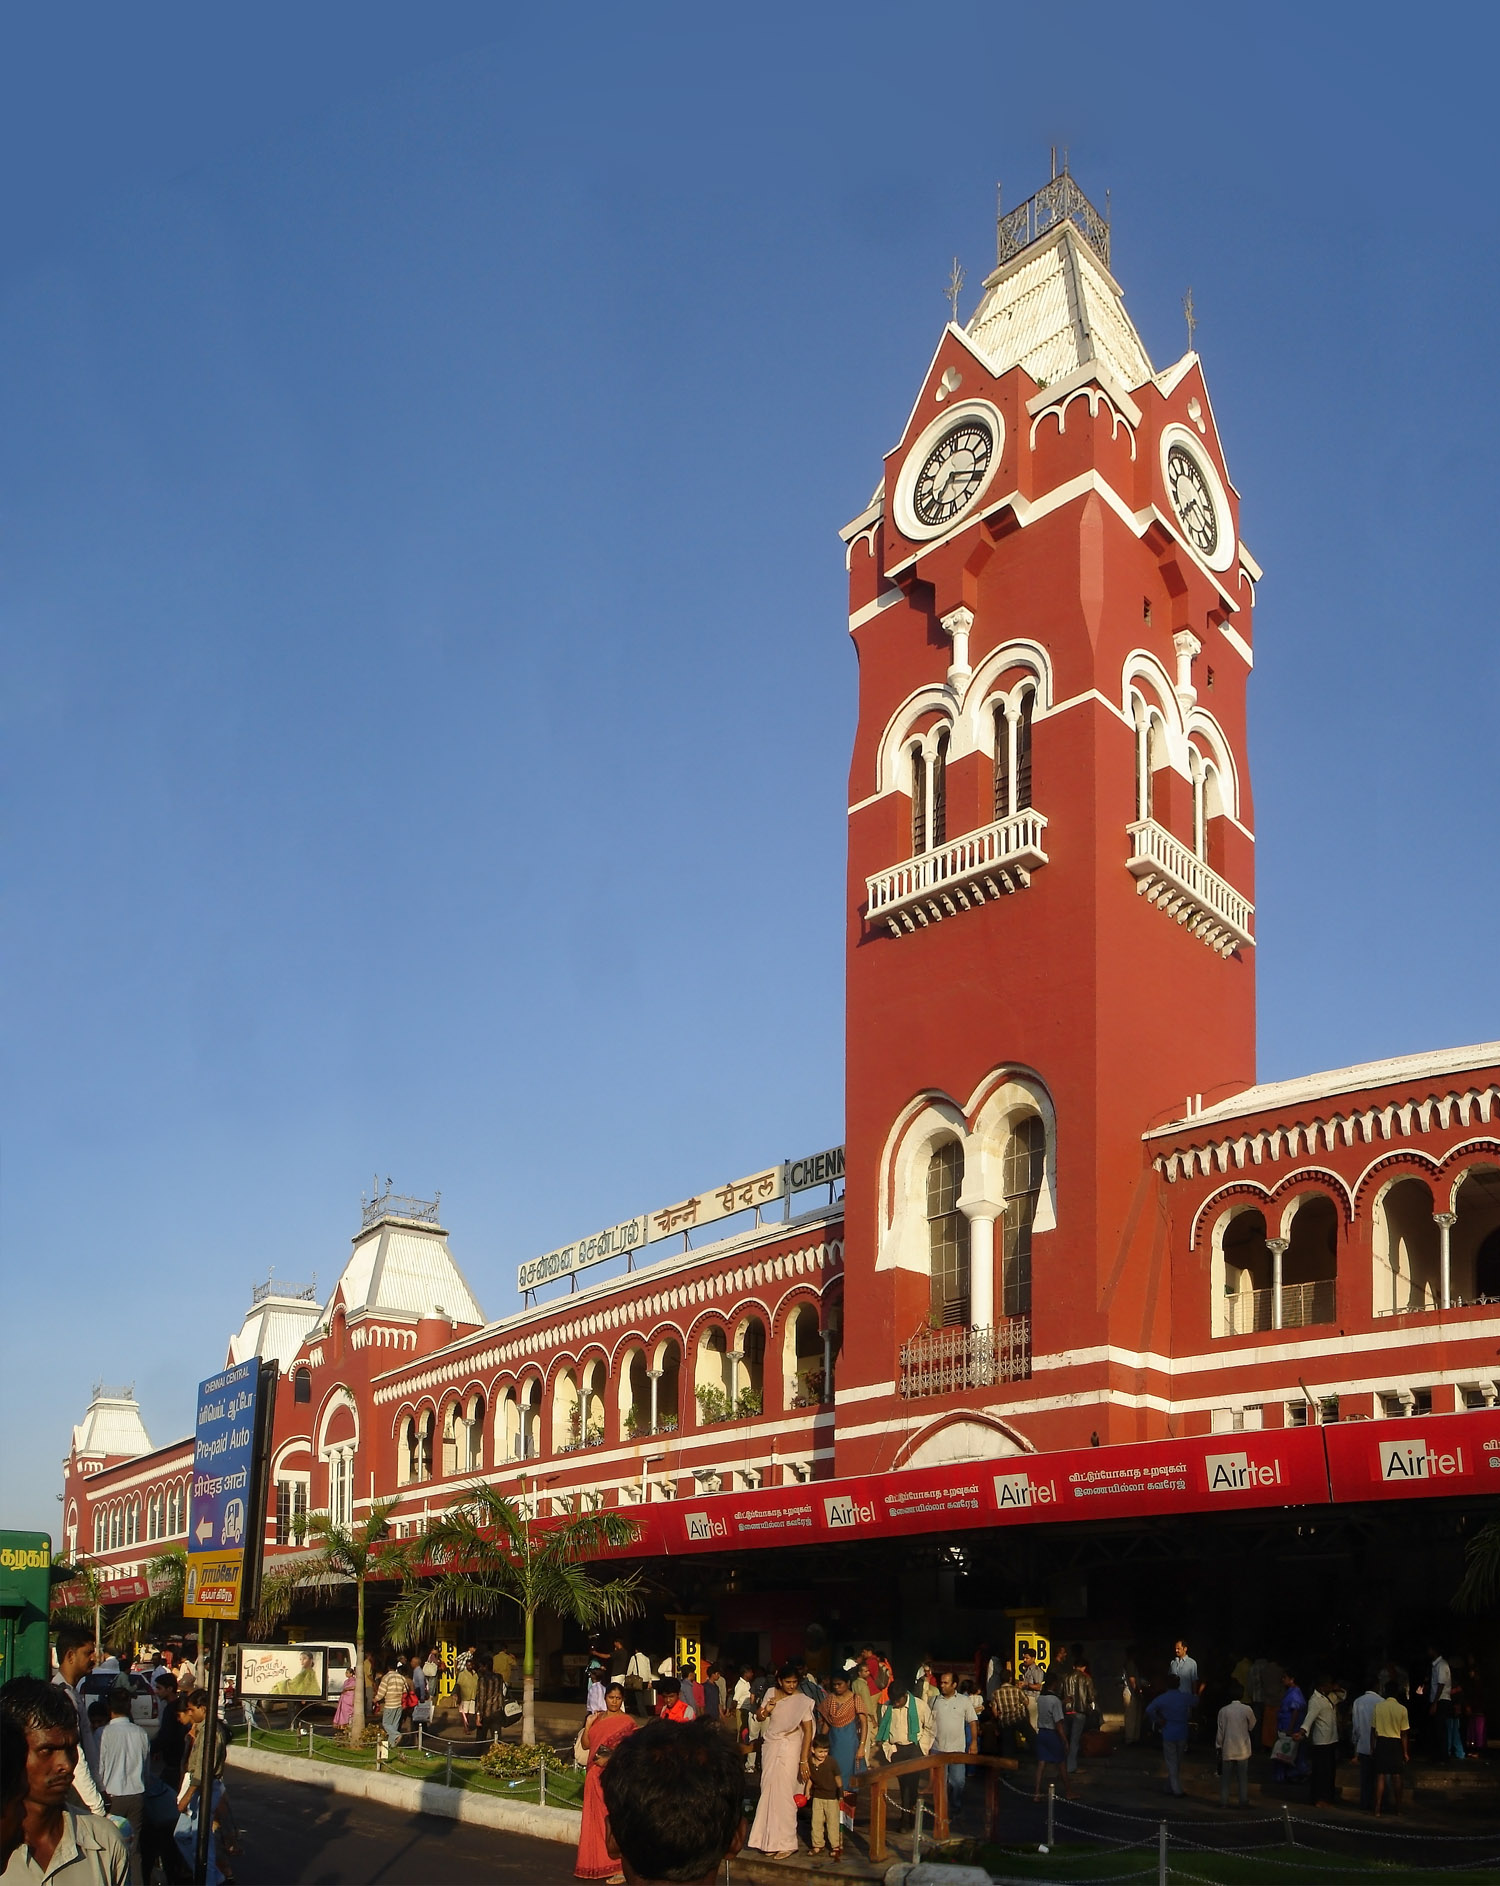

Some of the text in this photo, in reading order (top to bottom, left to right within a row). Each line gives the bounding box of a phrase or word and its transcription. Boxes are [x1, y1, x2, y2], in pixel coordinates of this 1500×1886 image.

[518, 1218, 640, 1287] சென்னை சென்ட்ரல்
[204, 1366, 250, 1394] CHENNAI CENTRAL
[227, 1391, 253, 1421] ஆட்டோ
[196, 1426, 250, 1461] Pre-paid Auto
[1143, 1462, 1187, 1476] உறவுகள்
[1212, 1459, 1281, 1490] Airtel
[1387, 1446, 1463, 1478] Airtel
[944, 1483, 979, 1498] உறவுகள்
[1000, 1479, 1056, 1507] Airtel
[1074, 1478, 1186, 1498] இணையில்லா கவரேஜ்
[830, 1501, 875, 1526] Airtel
[889, 1498, 979, 1518] இணையில்லா கவரேஜ்
[690, 1517, 728, 1541] Airtel
[0, 1541, 50, 1572] கழகம்
[201, 1564, 240, 1586] ராம்கோ
